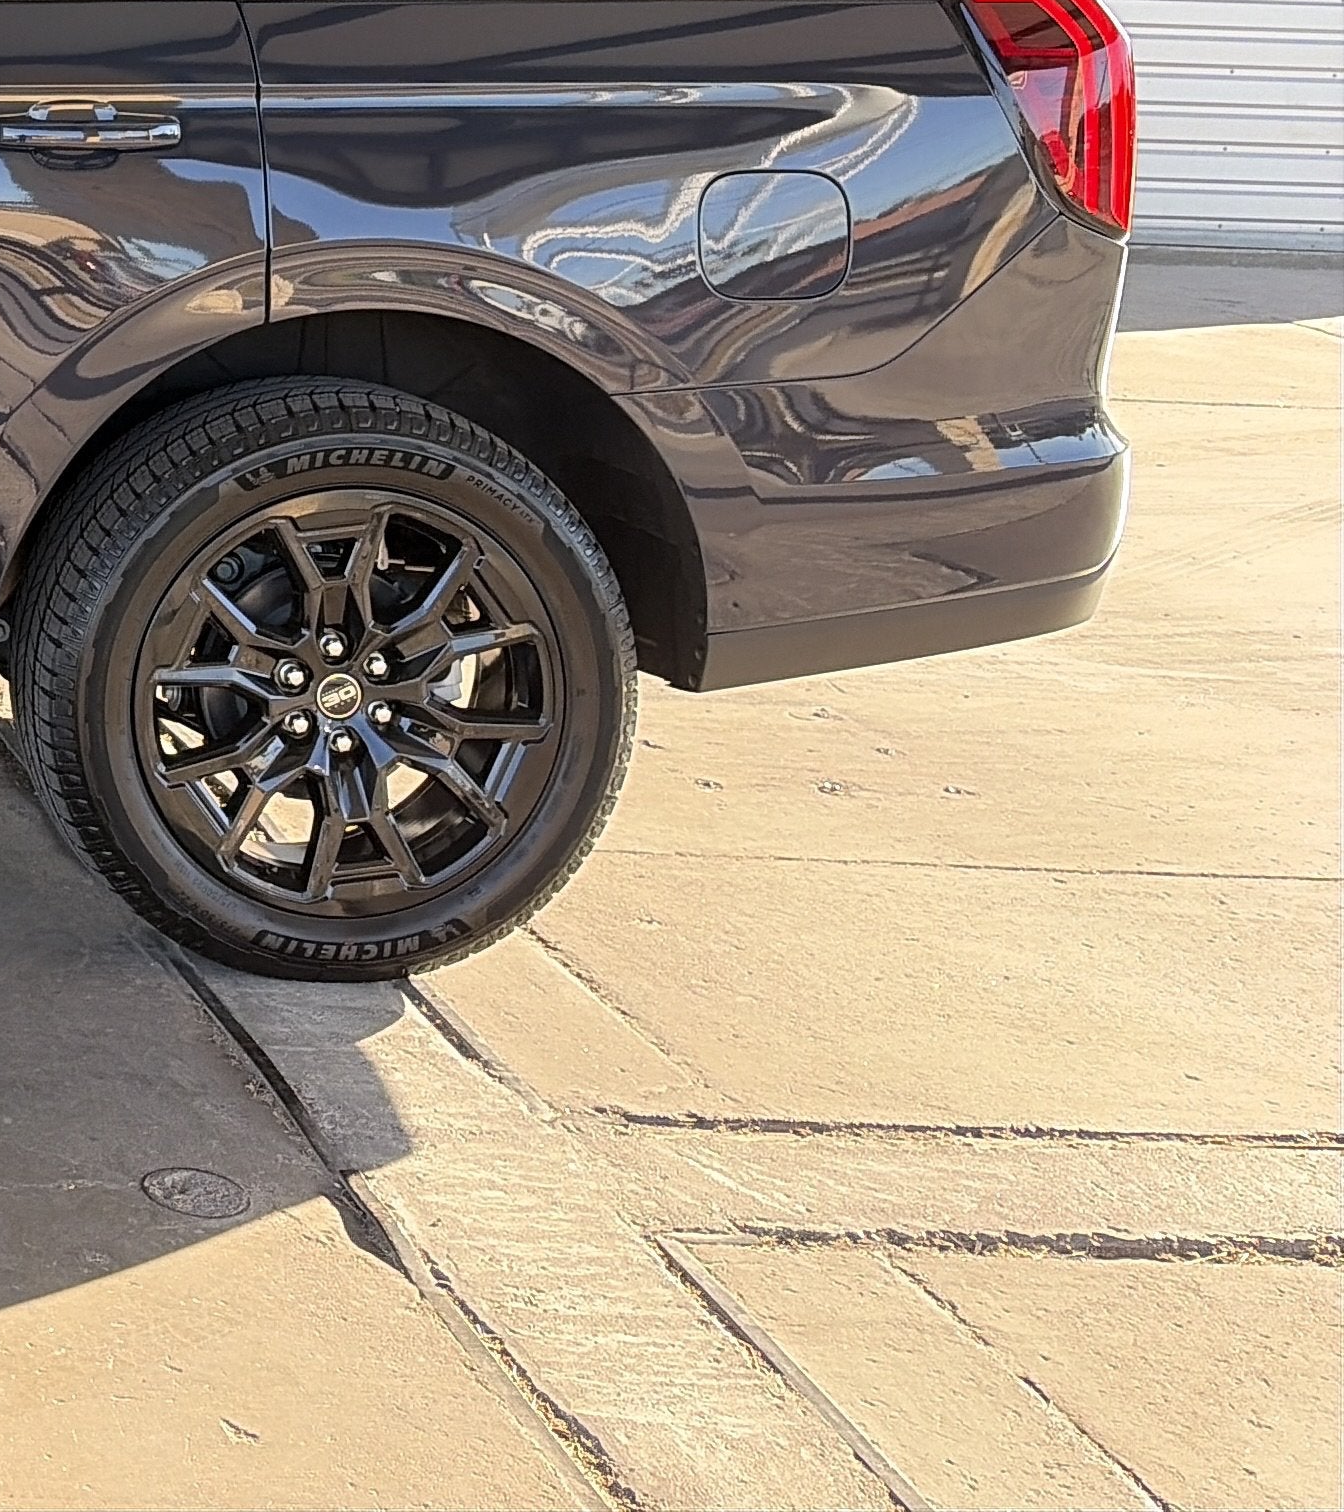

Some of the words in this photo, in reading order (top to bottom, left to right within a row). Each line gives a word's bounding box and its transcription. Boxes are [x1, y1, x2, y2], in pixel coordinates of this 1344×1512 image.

[285, 449, 447, 476] MICHELIN
[465, 474, 520, 511] PRIMACY
[259, 932, 420, 961] MICHELIN
